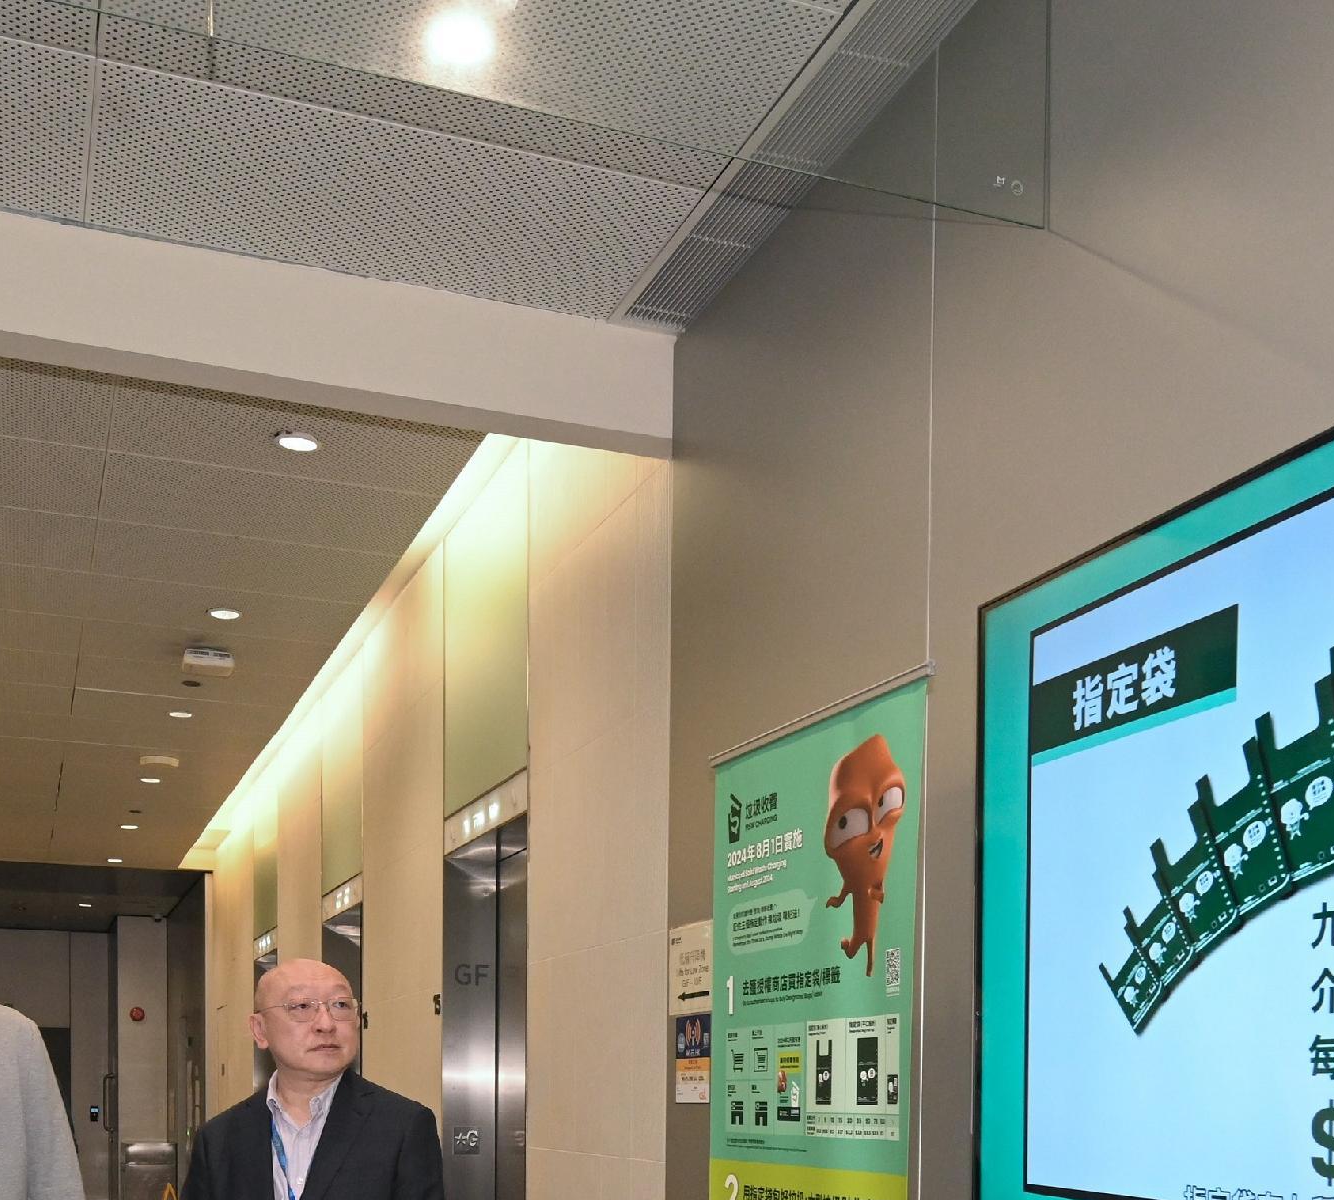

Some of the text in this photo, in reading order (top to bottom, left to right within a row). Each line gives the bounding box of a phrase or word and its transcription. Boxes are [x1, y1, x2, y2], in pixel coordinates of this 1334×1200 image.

[1071, 645, 1178, 731] 指定袋
[727, 828, 803, 868] 2024年8月1日實施
[454, 963, 491, 986] GF
[726, 975, 734, 1015] 1
